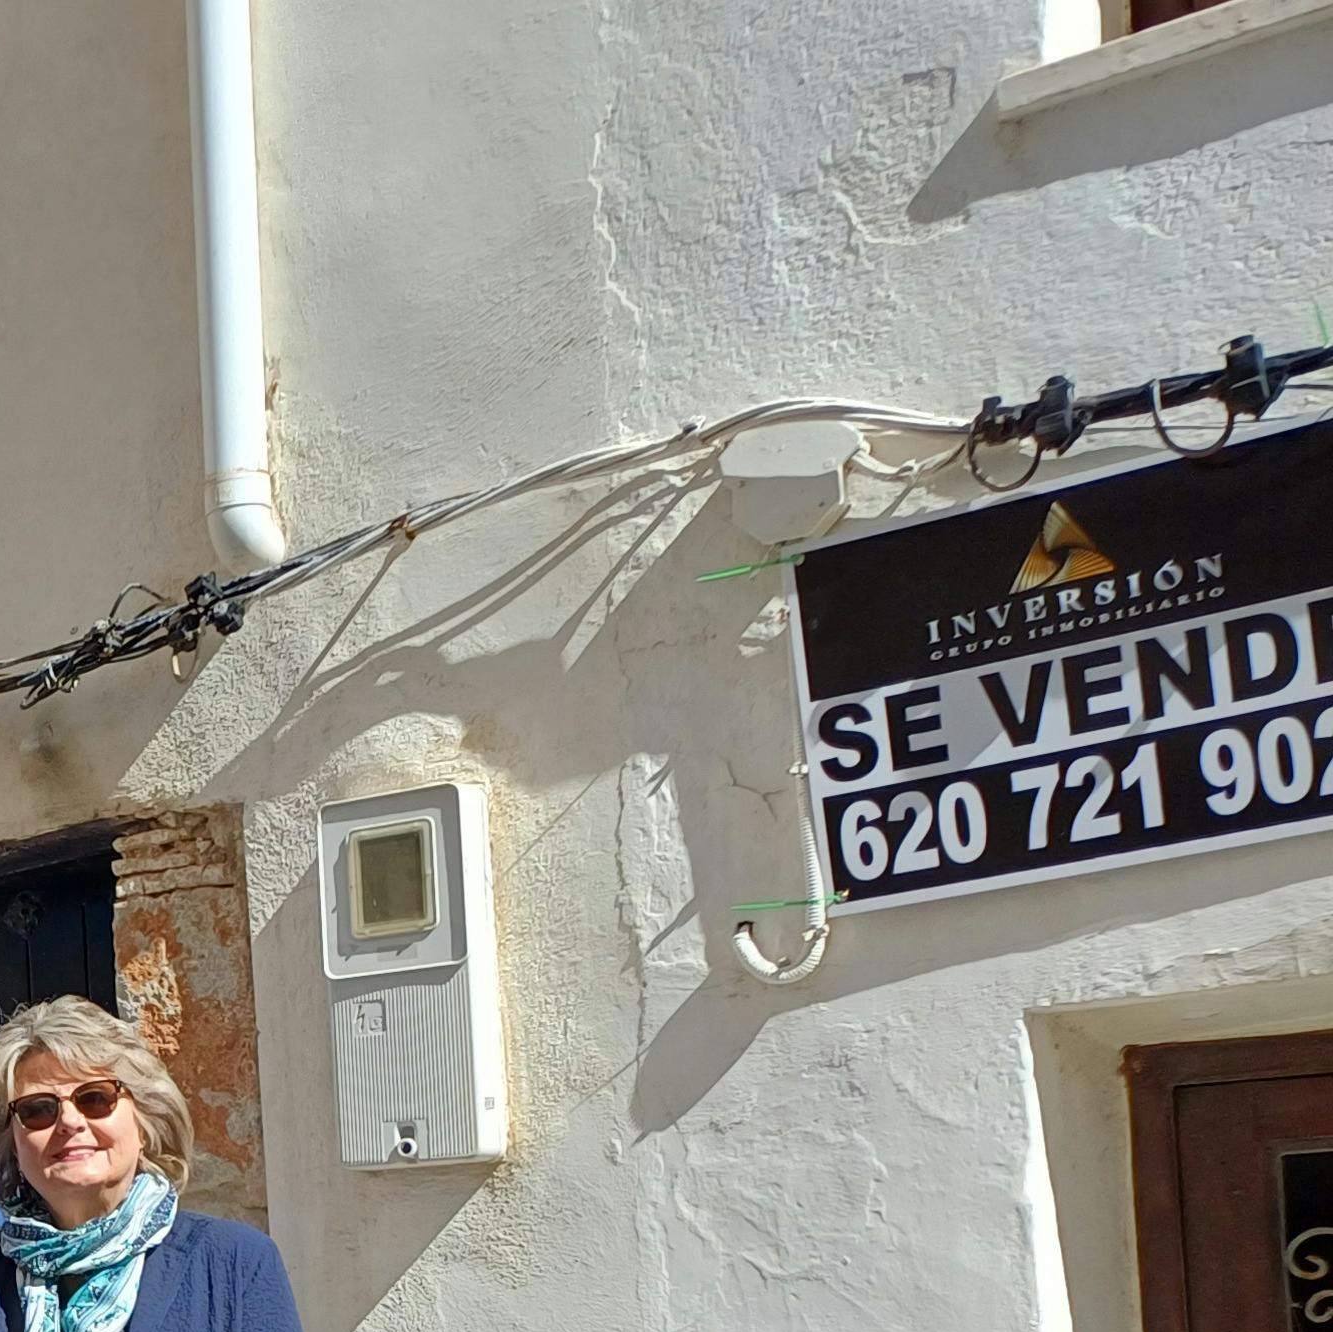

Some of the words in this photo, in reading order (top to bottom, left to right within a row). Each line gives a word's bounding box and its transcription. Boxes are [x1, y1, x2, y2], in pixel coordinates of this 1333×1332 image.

[925, 553, 1224, 645] INVERSIÓN
[929, 634, 1013, 662] GRUPO
[1027, 585, 1226, 641] INMOBILIARIO
[817, 684, 950, 782] SE
[839, 780, 988, 882] 620
[1010, 740, 1165, 851] 721
